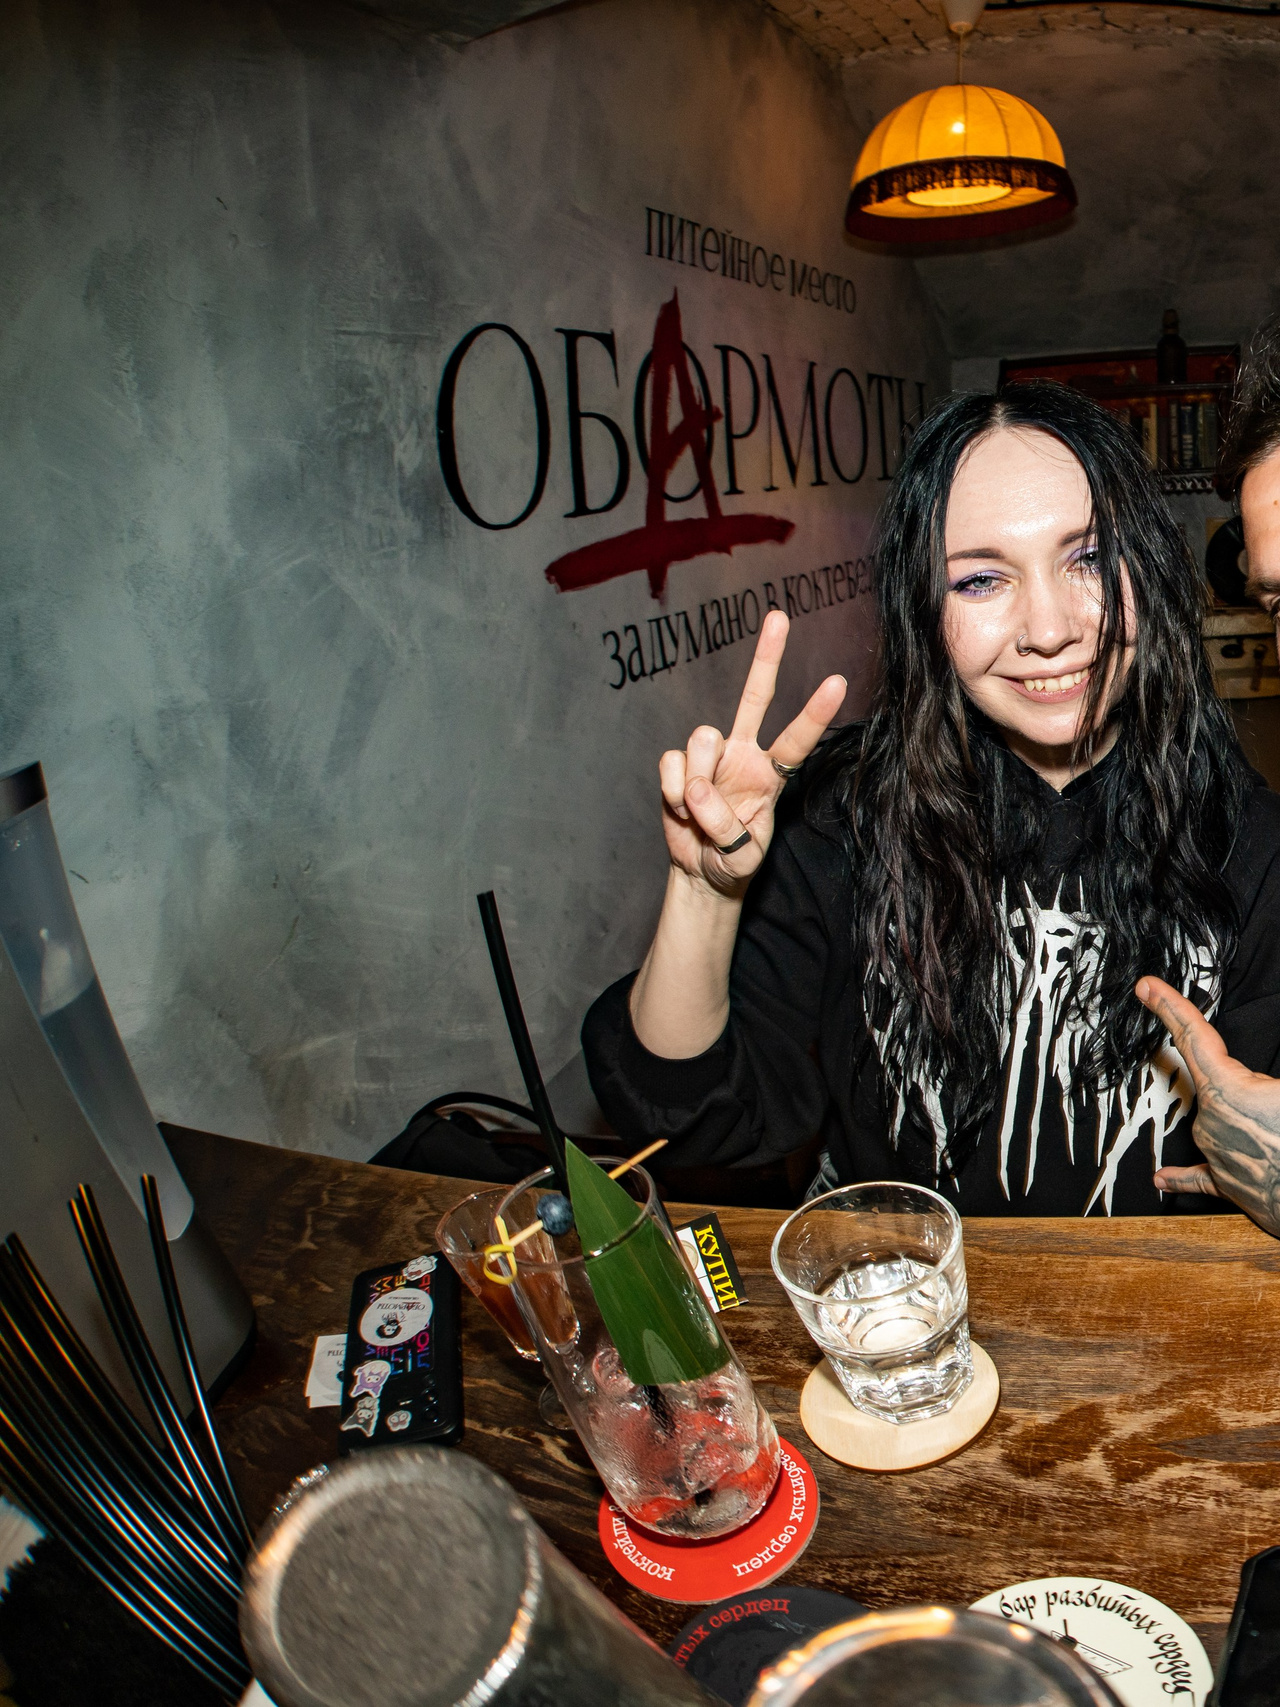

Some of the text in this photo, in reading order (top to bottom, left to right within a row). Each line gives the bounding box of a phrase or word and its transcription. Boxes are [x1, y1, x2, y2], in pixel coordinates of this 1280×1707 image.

[646, 206, 857, 314] питейное место
[602, 589, 760, 690] задумано
[612, 1515, 676, 1581] коктейли
[732, 1524, 798, 1577] сердец
[708, 1598, 791, 1628] сердец
[999, 1583, 1195, 1695] бар разбитых сердец
